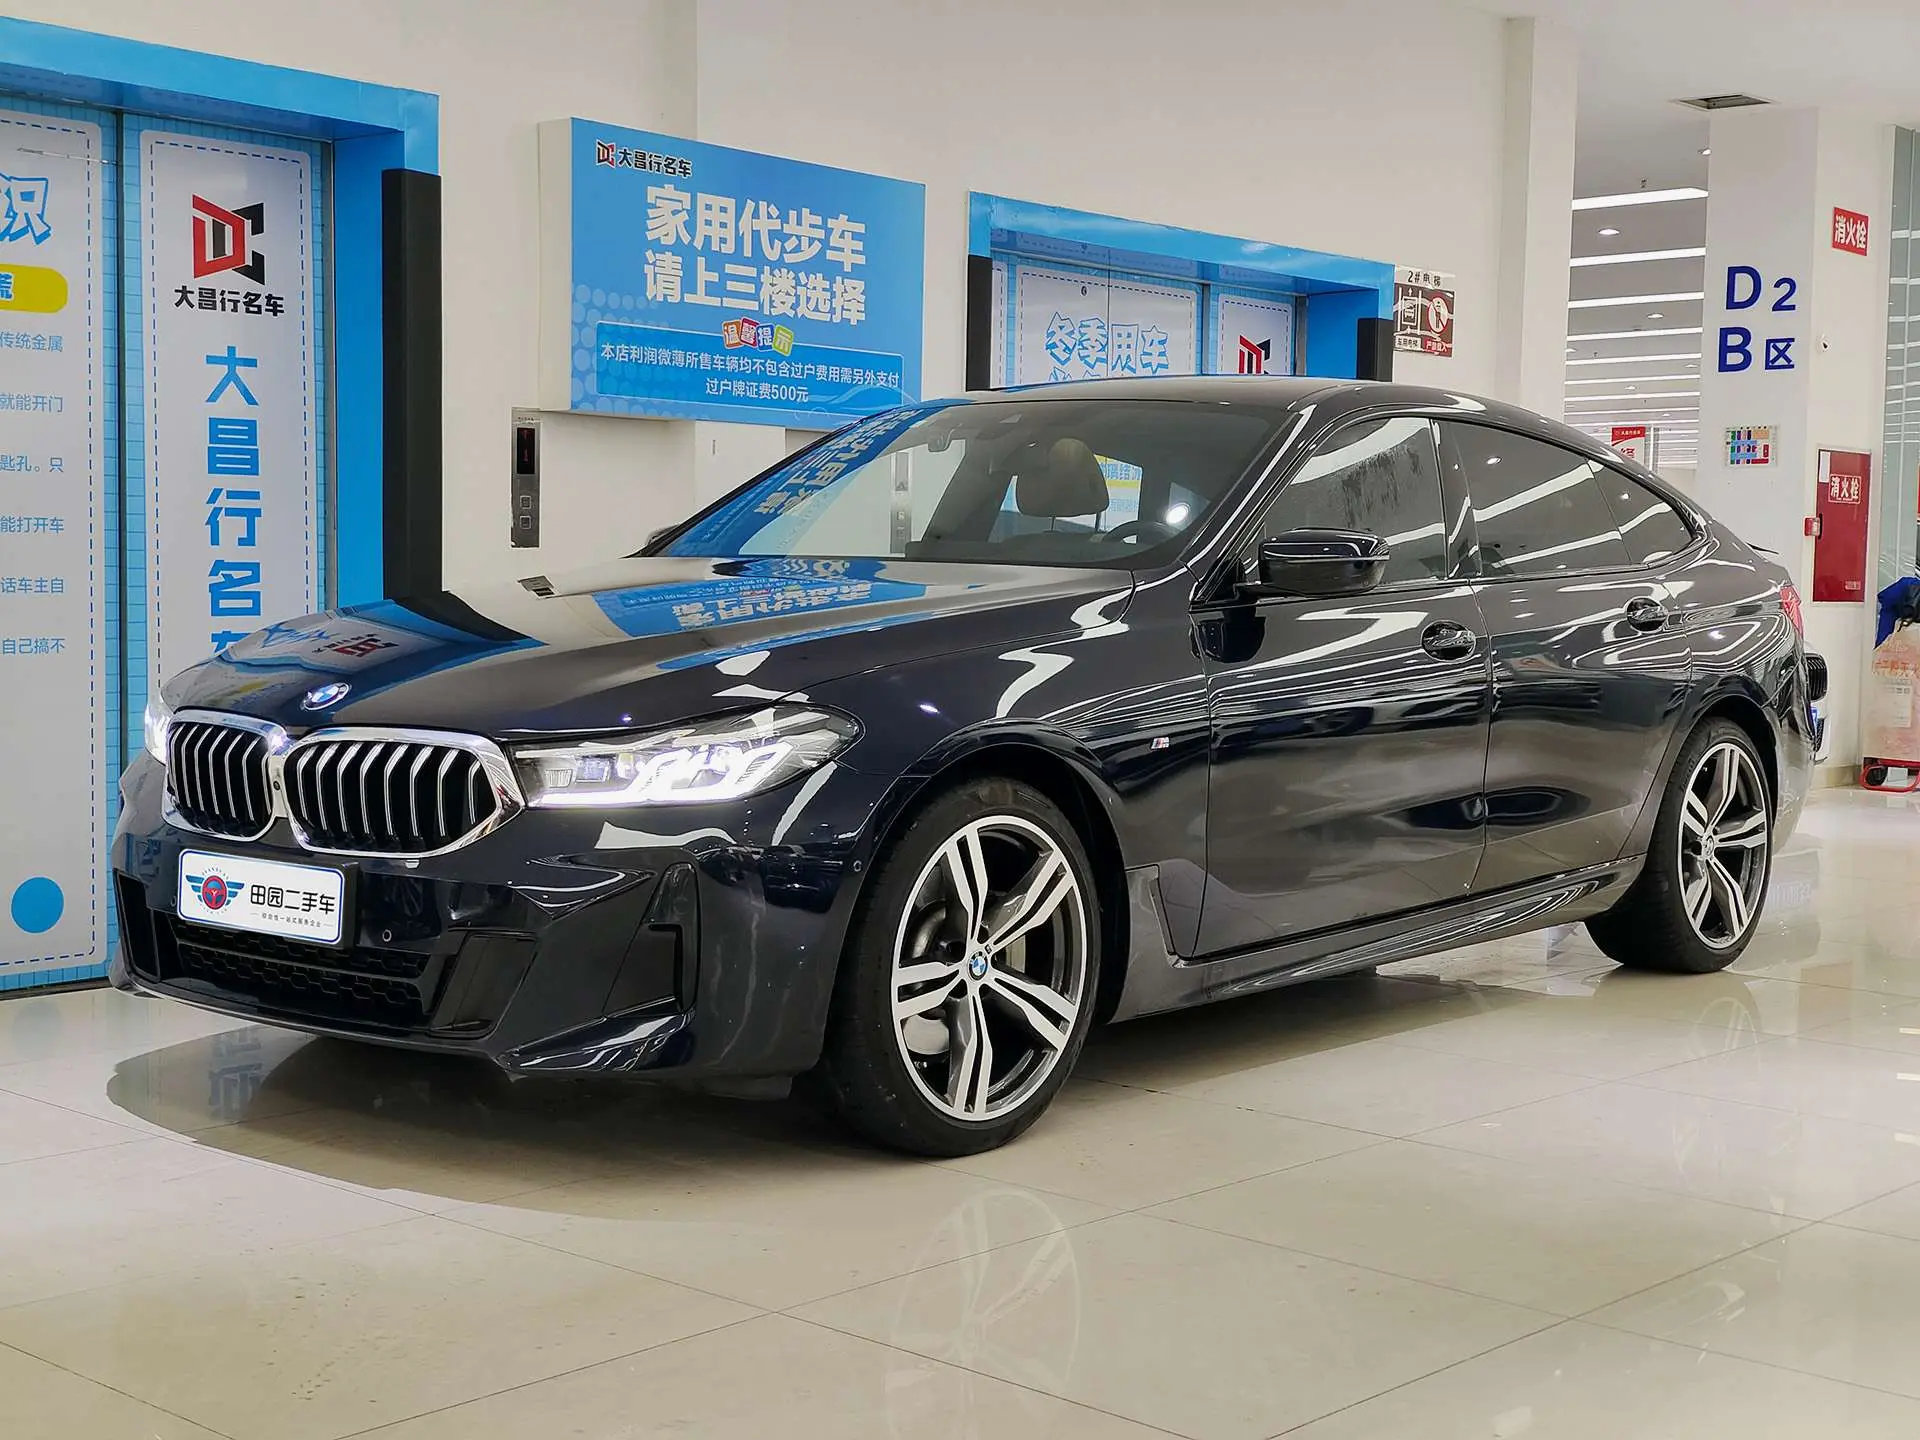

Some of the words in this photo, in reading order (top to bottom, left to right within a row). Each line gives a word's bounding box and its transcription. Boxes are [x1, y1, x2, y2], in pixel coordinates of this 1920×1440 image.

[618, 147, 692, 178] 大昌行名车
[644, 183, 866, 272] 家用代步车
[1834, 214, 1867, 248] 消火栓
[174, 284, 285, 317] 大昌行名车
[643, 248, 866, 326] 请上三楼选择
[0, 331, 63, 352] 传统金属
[1045, 311, 1169, 374] 冬季用车
[600, 343, 900, 388] 本店利润微薄所售车辆均不包含过户费用需另外支付
[0, 393, 63, 413] 就能开门
[705, 377, 809, 403] 过户牌证费500元
[204, 345, 263, 654] 大昌行名
[1830, 476, 1860, 500] 消火栓
[0, 516, 65, 534] 能打开车
[0, 577, 65, 594] 话车主自
[2, 638, 66, 655] 自己搞不
[250, 884, 336, 915] 田园二手车
